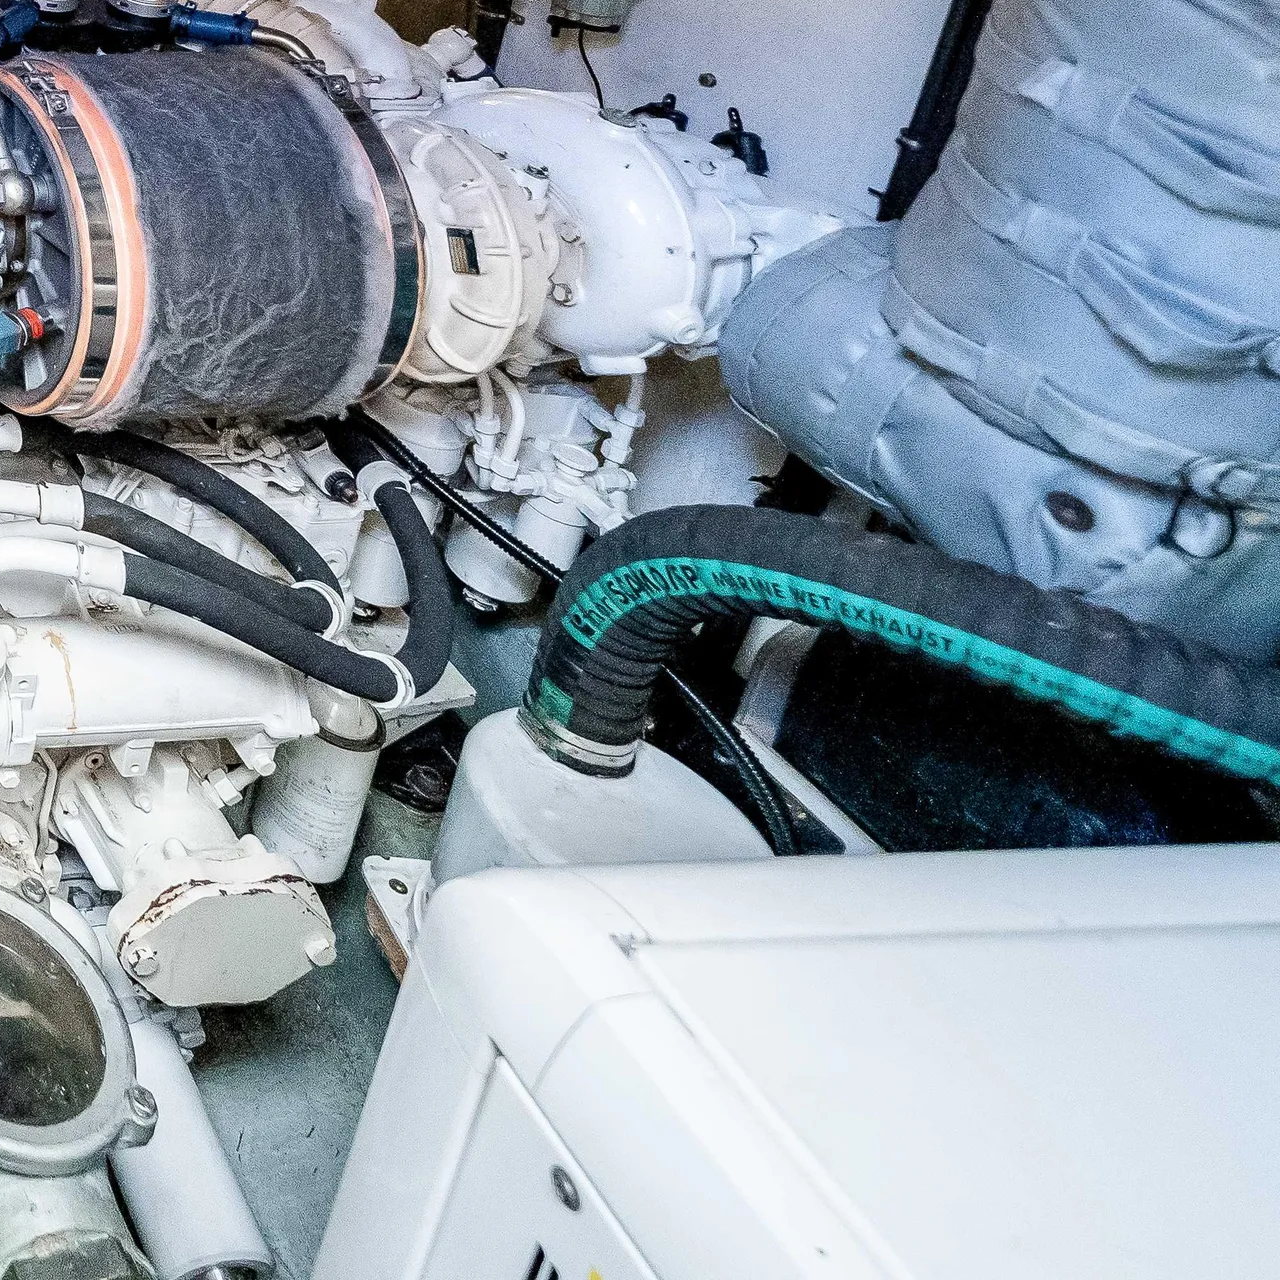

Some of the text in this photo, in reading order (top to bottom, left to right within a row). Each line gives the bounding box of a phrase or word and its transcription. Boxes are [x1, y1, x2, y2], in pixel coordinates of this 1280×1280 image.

[711, 572, 785, 599] MARINE
[792, 587, 831, 612] WET
[840, 602, 954, 654] EXHAUST
